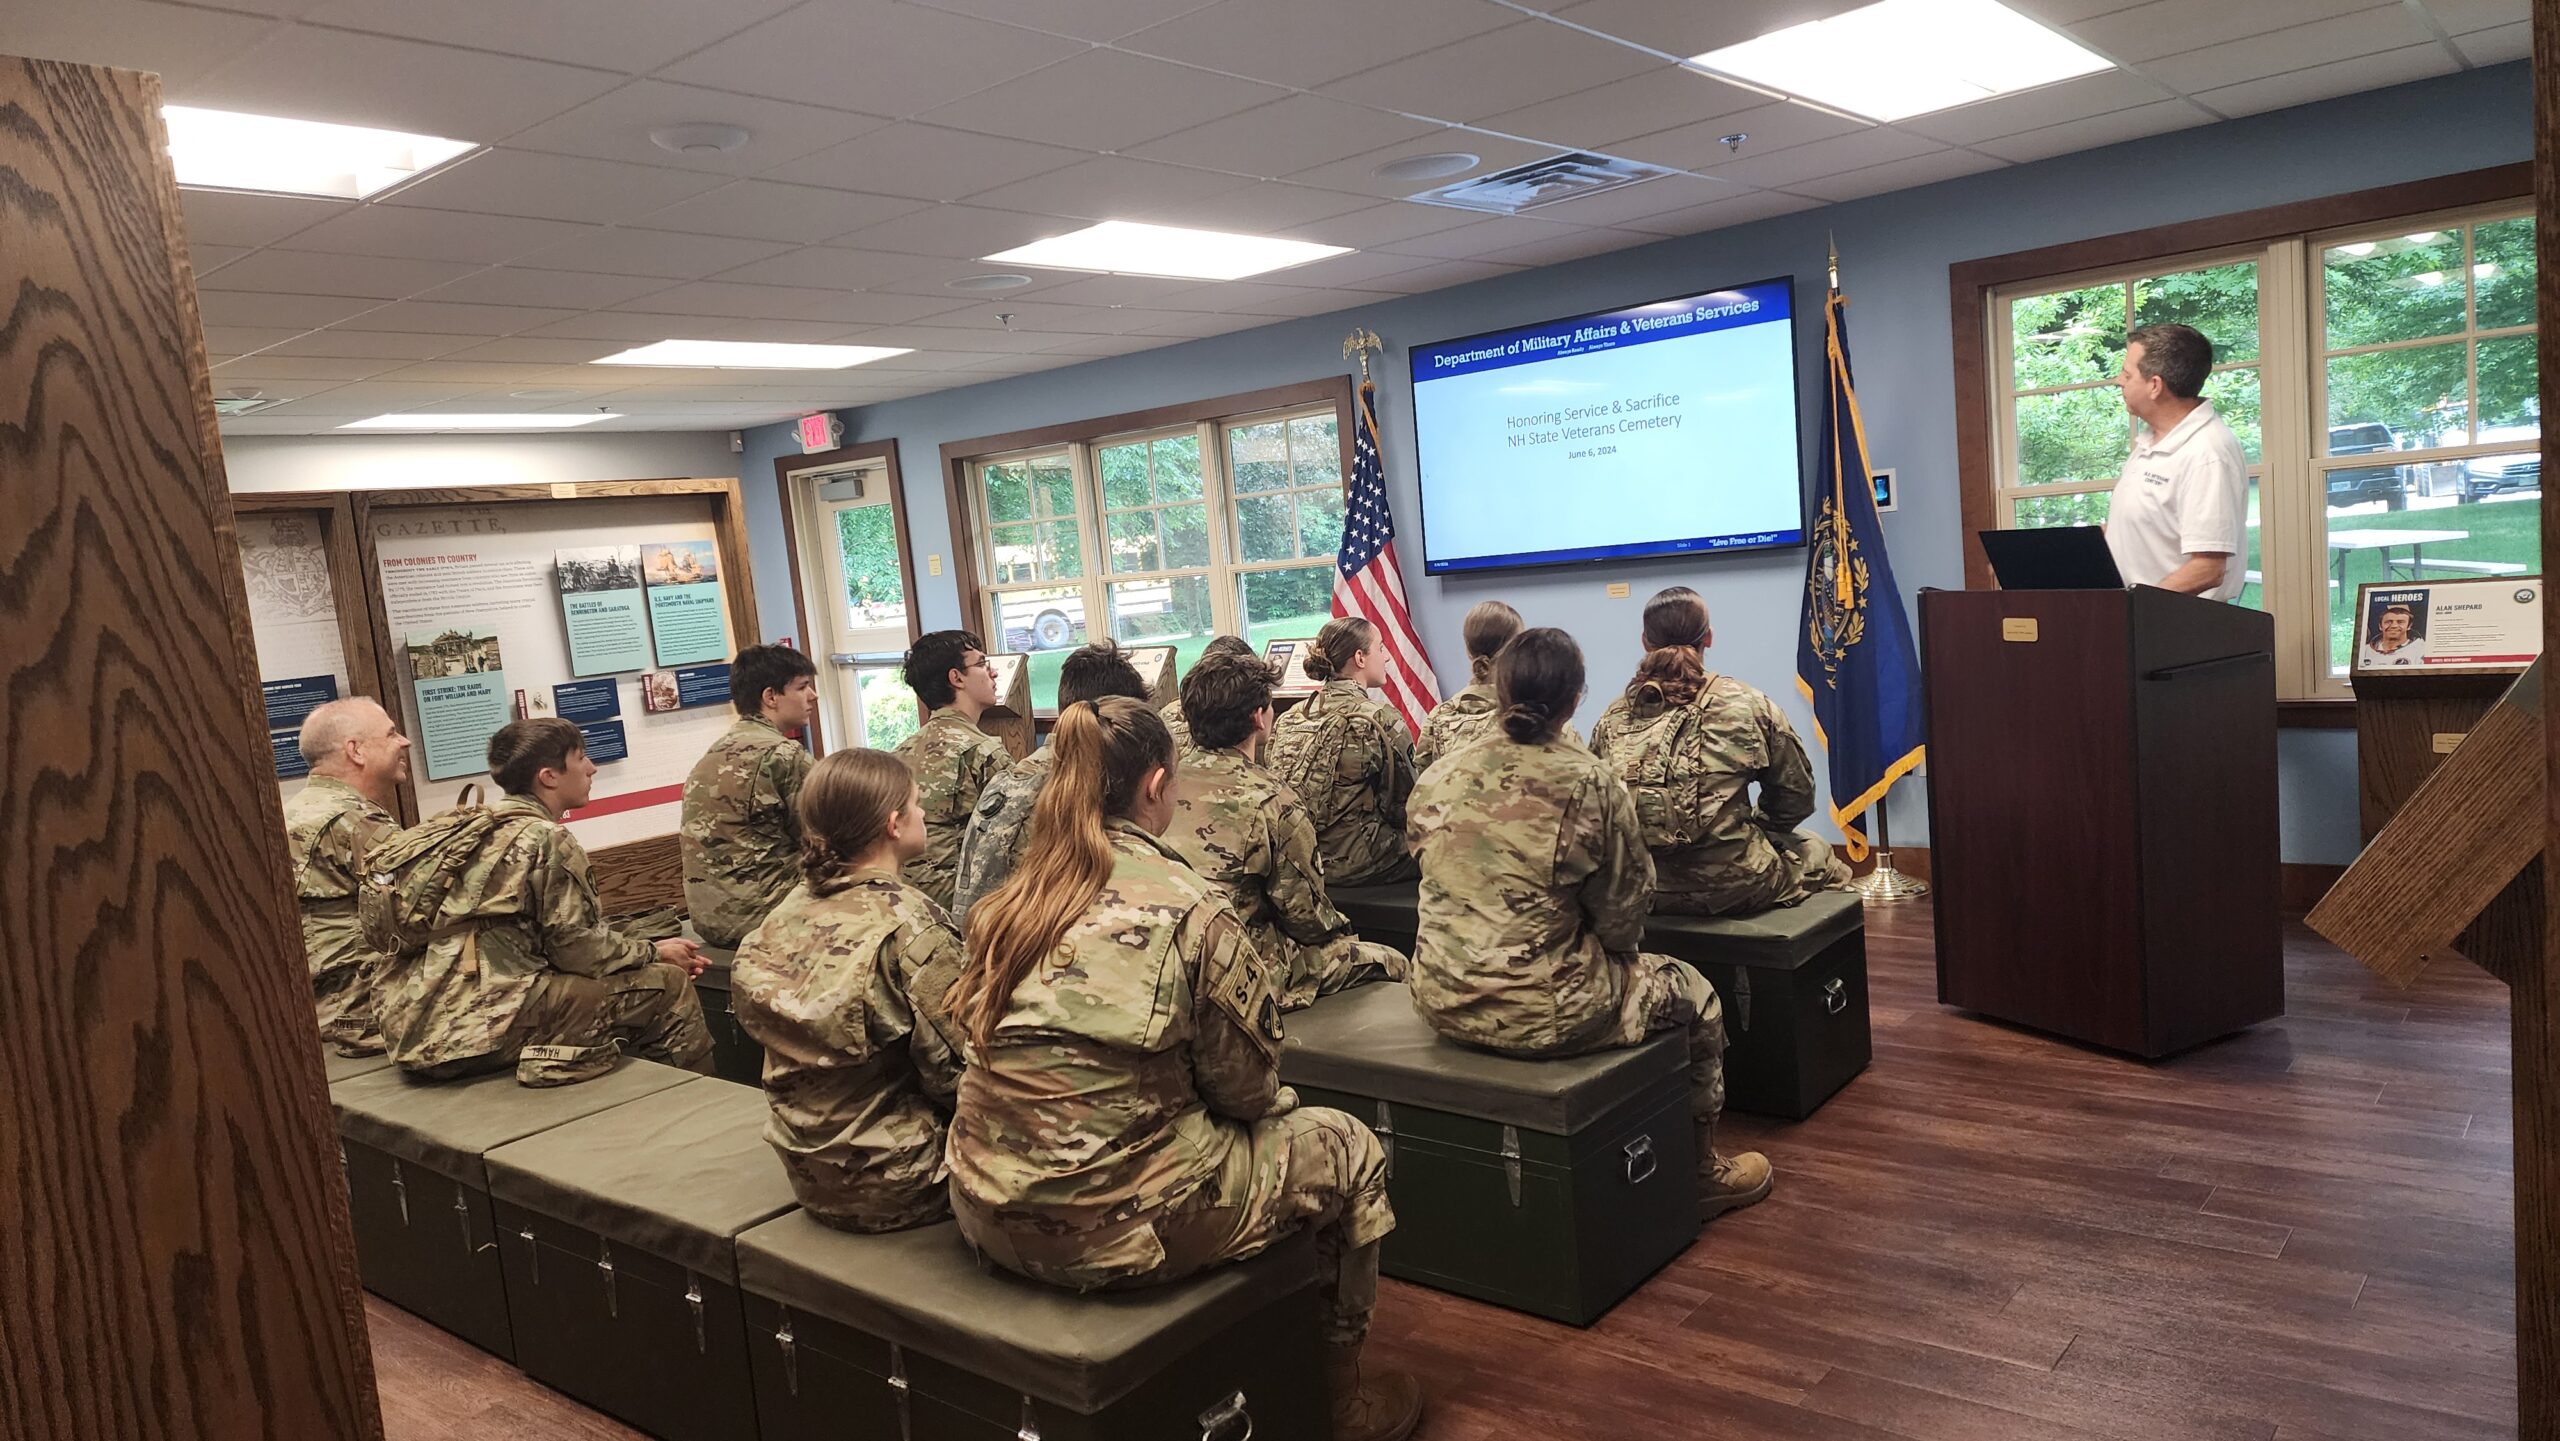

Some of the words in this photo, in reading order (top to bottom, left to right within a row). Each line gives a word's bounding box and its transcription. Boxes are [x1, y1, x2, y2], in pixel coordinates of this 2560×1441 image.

[1434, 346, 1505, 368] Department
[1507, 340, 1520, 355] of
[1521, 334, 1571, 353] Military
[1573, 325, 1617, 343] Affairs
[1620, 320, 1631, 335] &
[1632, 311, 1693, 332] Veterans
[1695, 300, 1760, 321] Services
[1507, 411, 1561, 429] Honoring
[1564, 404, 1608, 421] Service
[1612, 400, 1622, 414] &
[1625, 392, 1680, 412] Sacrifice
[1507, 434, 1526, 448] NH
[1529, 431, 1559, 445] State
[1561, 422, 1616, 440] Veterans
[1619, 414, 1682, 433] Cemetery
[1568, 450, 1587, 459] June
[1588, 448, 1596, 458] 6,
[1597, 445, 1617, 455] 2024
[1729, 537, 1746, 546] Free
[383, 559, 402, 567] FROM
[403, 557, 436, 566] COLONIES
[438, 556, 446, 564] TO
[447, 554, 477, 563] COUNTRY
[2391, 593, 2424, 602] HEROES
[437, 686, 456, 694] STRIKE:
[445, 692, 466, 700] WILLIAM
[1235, 963, 1258, 1004] S-4
[532, 1047, 560, 1058] HAMEL
